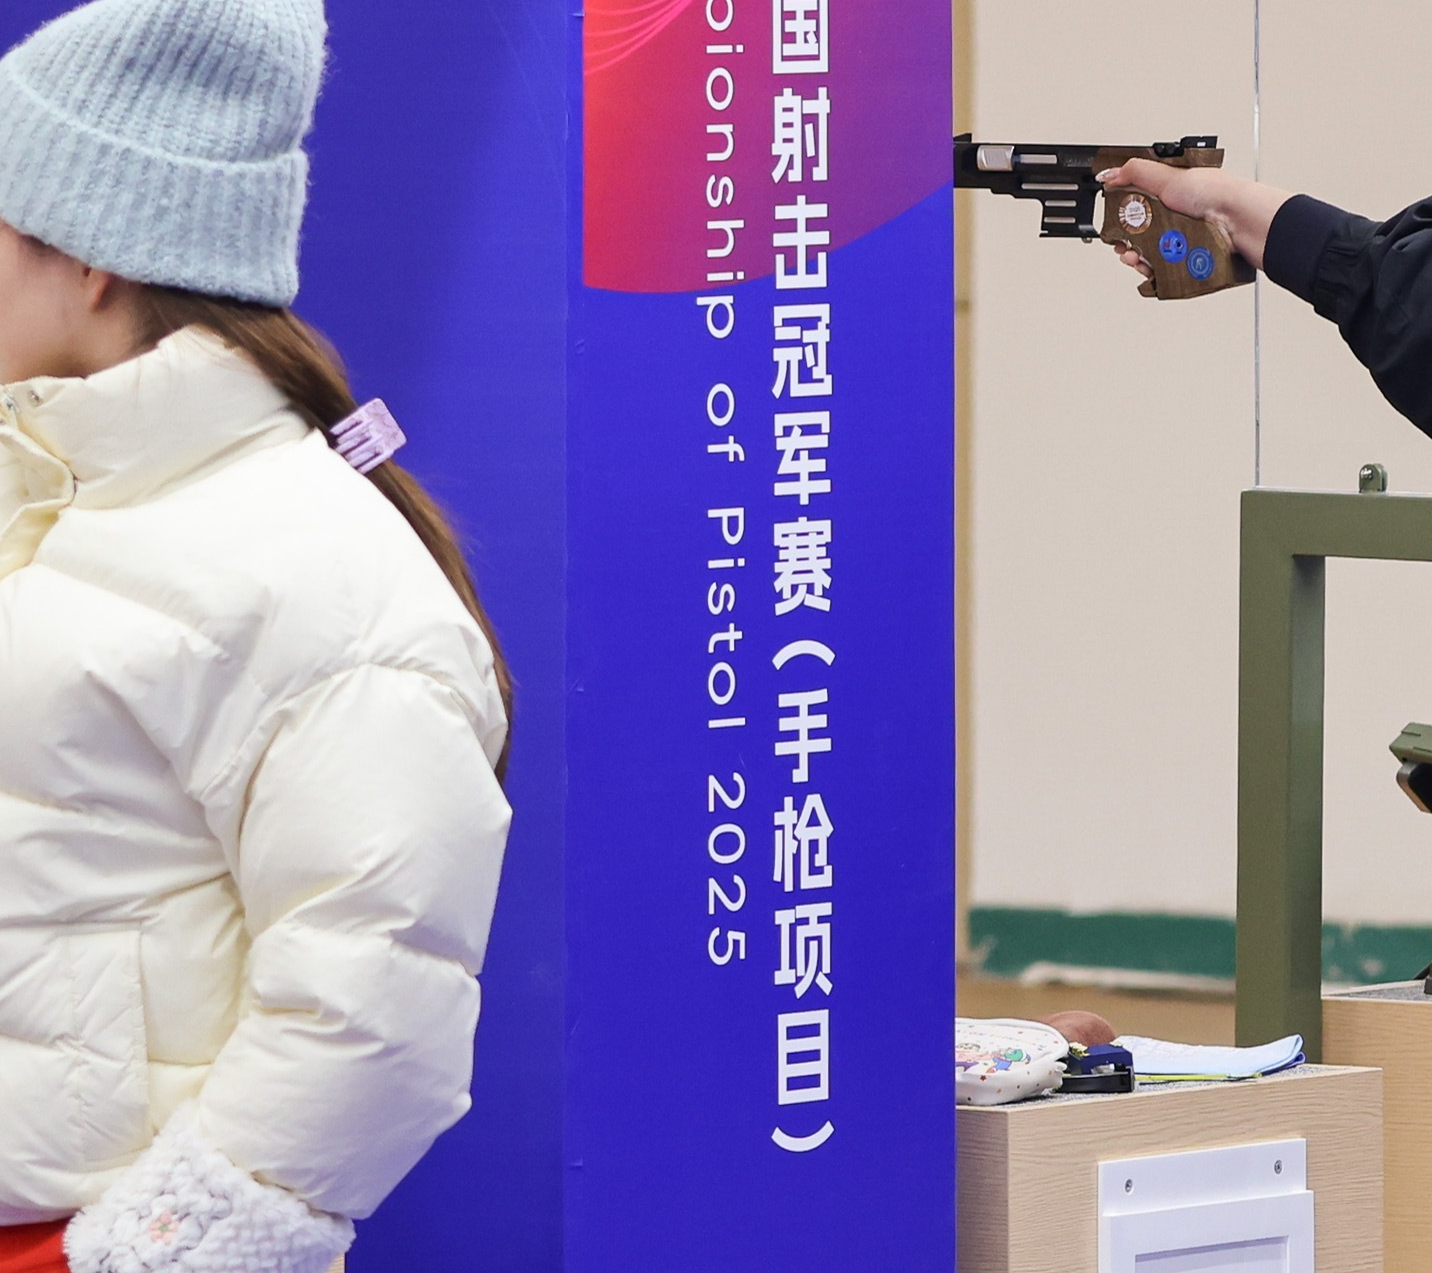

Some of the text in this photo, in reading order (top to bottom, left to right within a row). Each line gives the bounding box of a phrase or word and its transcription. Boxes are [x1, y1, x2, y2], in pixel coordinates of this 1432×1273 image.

[706, 383, 745, 462] of
[706, 507, 746, 730] Pistol
[707, 772, 747, 966] 2025
